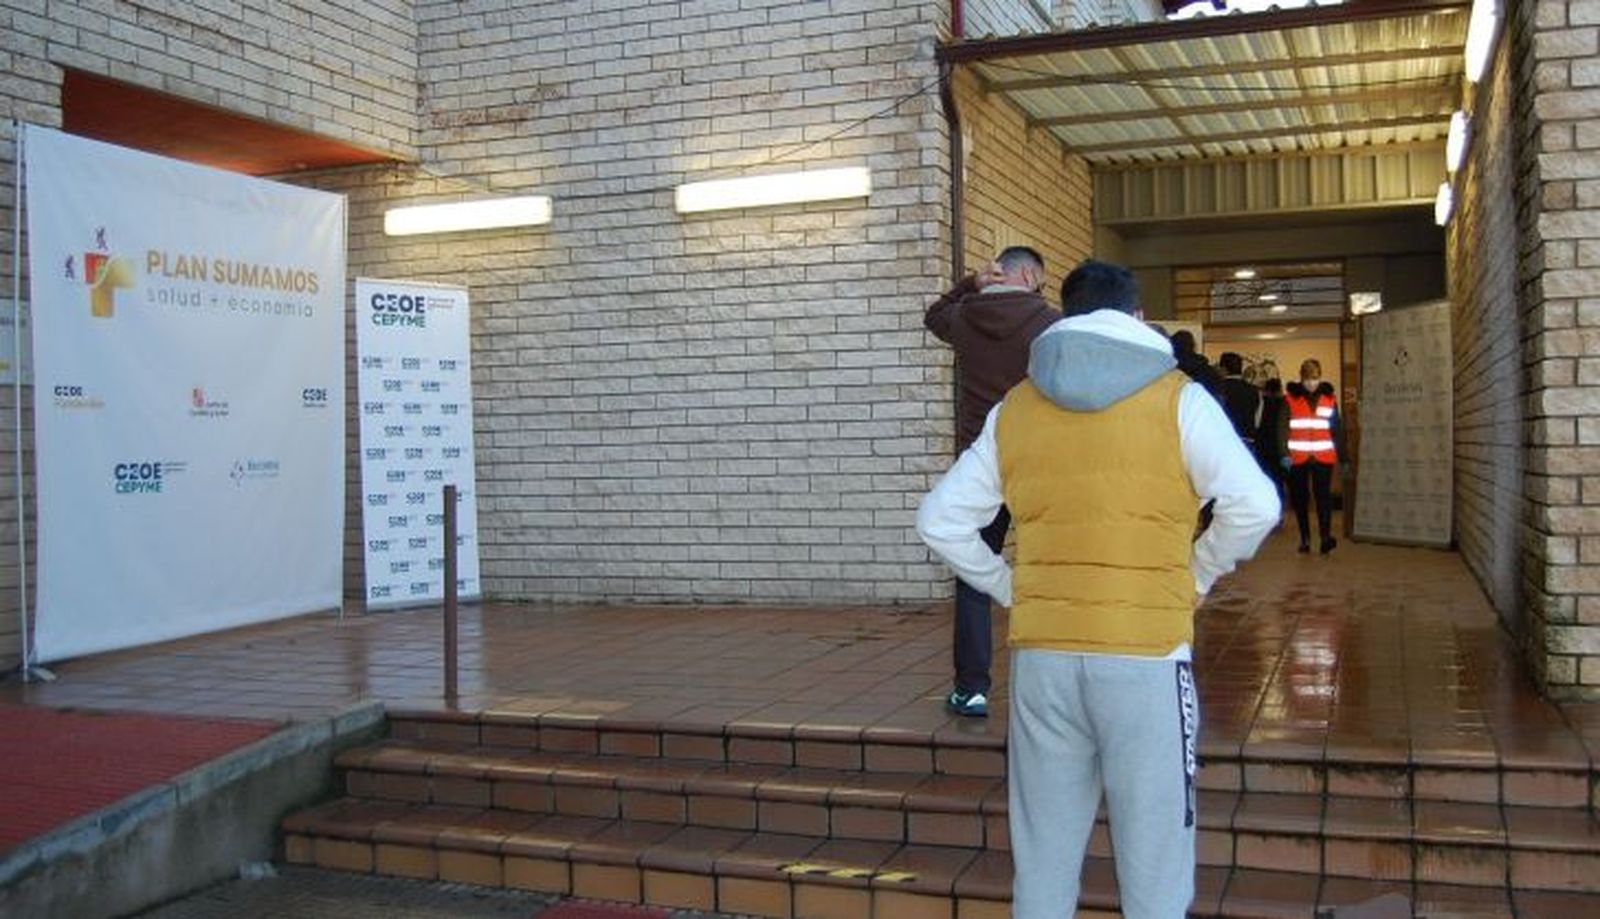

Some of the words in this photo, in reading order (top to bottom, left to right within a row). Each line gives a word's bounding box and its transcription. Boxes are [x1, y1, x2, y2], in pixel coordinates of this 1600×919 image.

[146, 249, 207, 281] PLAN
[213, 260, 319, 294] SUMAMOS
[147, 287, 201, 307] salud
[371, 293, 425, 313] CEOE
[371, 313, 426, 329] CEPYME
[114, 462, 162, 480] CEOE
[115, 481, 162, 493] CEPYME
